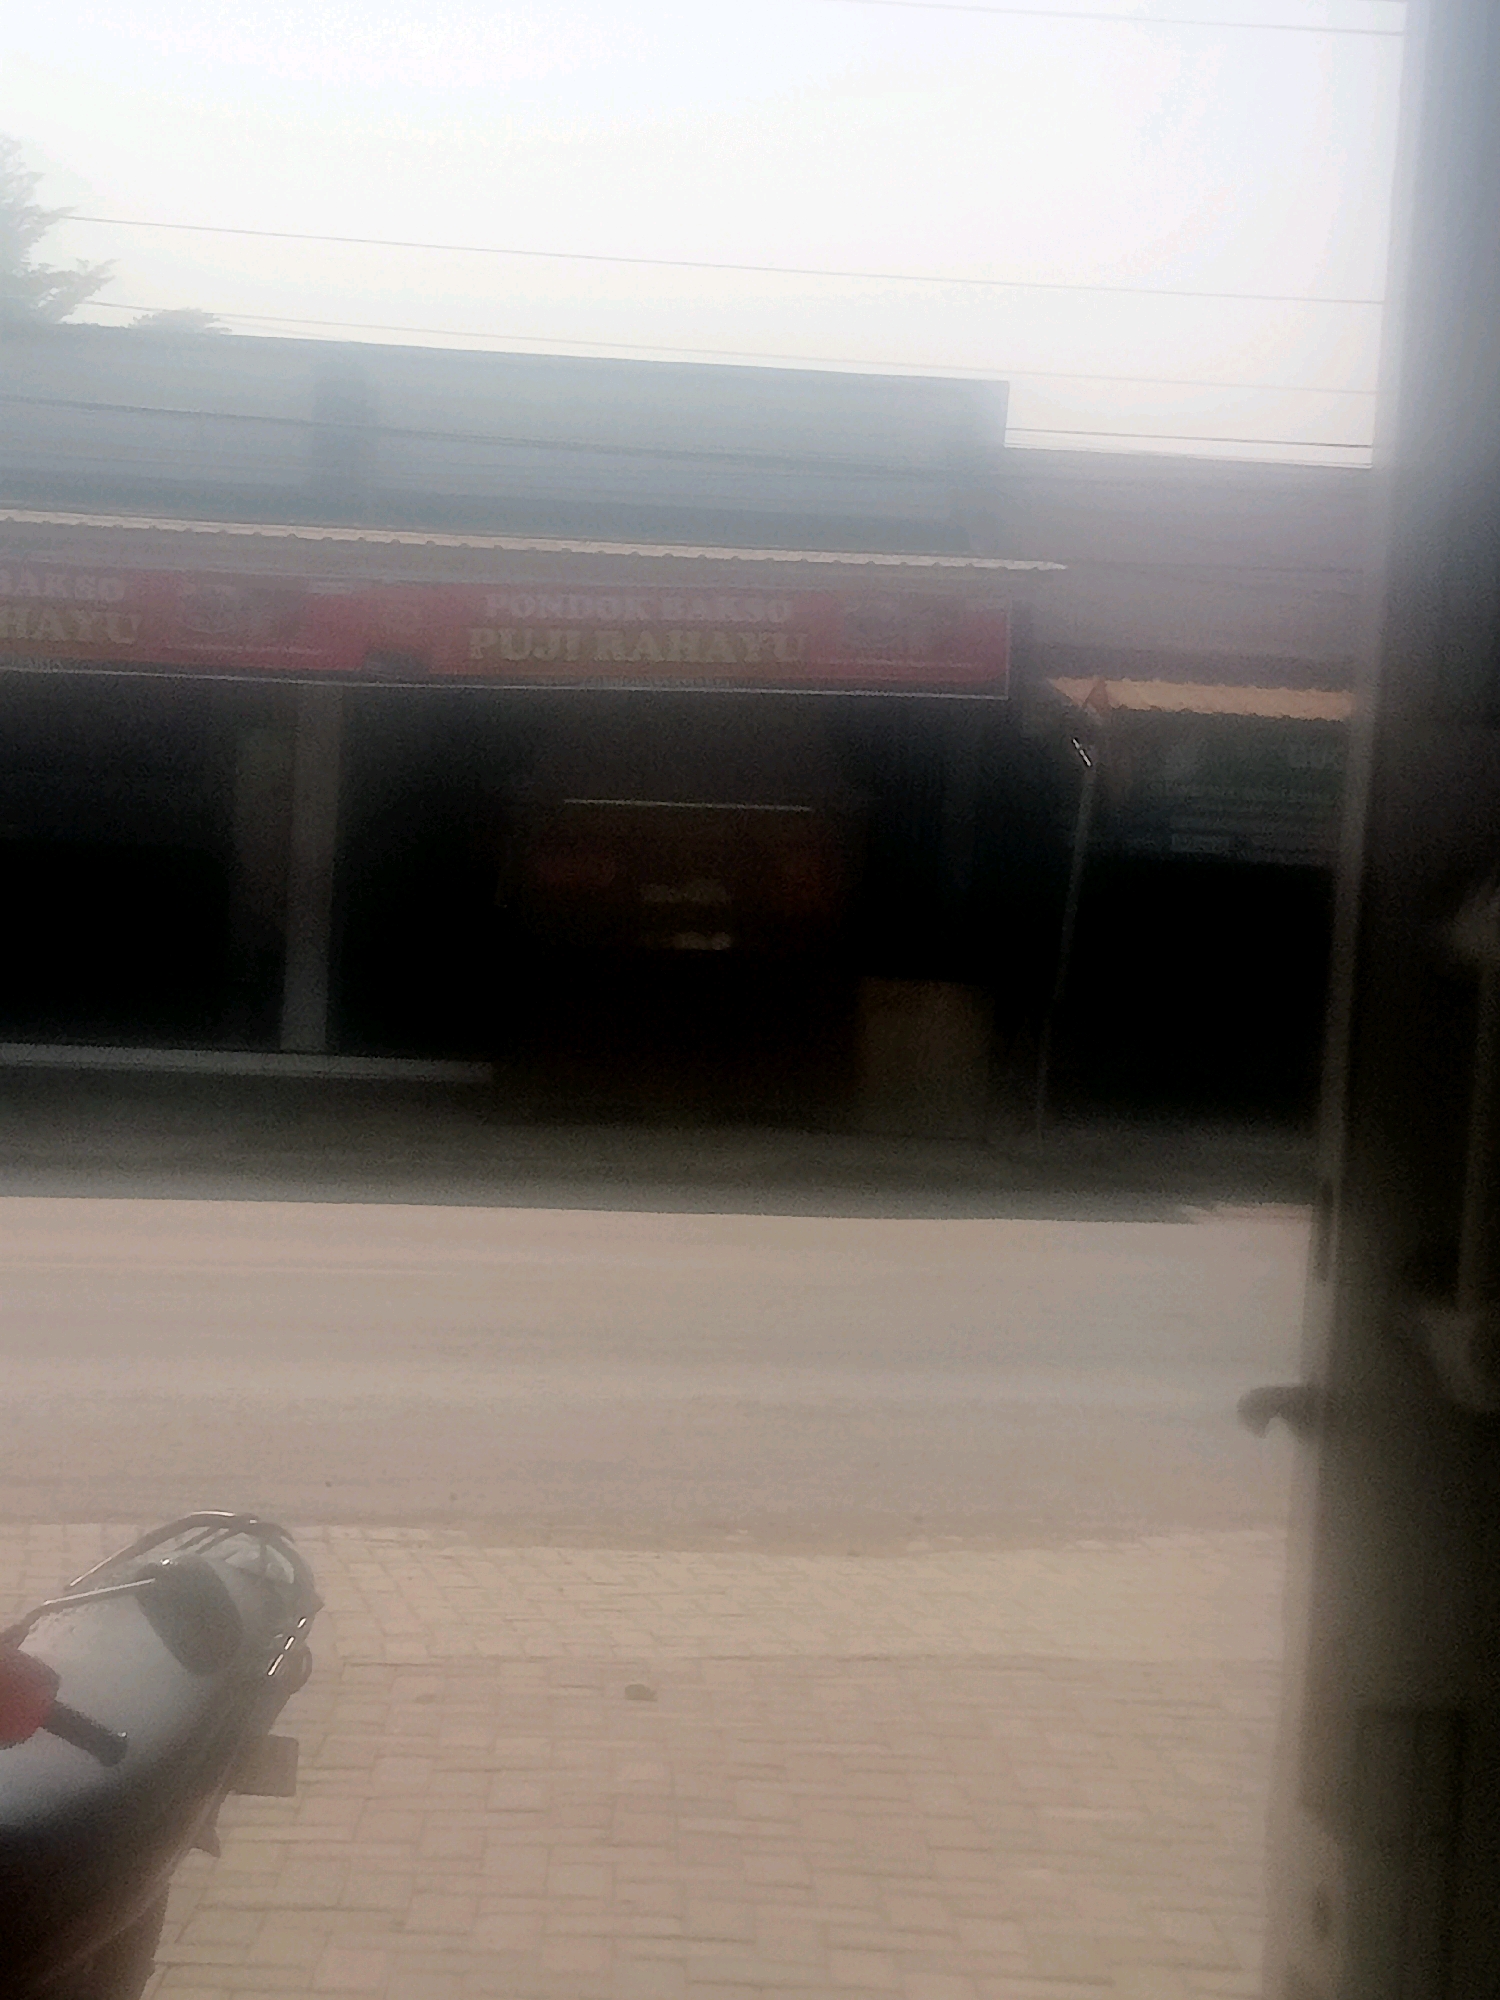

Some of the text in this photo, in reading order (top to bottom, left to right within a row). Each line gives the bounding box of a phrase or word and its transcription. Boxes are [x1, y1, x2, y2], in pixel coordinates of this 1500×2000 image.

[486, 592, 793, 623] PONDOK BAKSO
[468, 626, 582, 661] PUJI
[594, 630, 808, 663] RAHAYU
